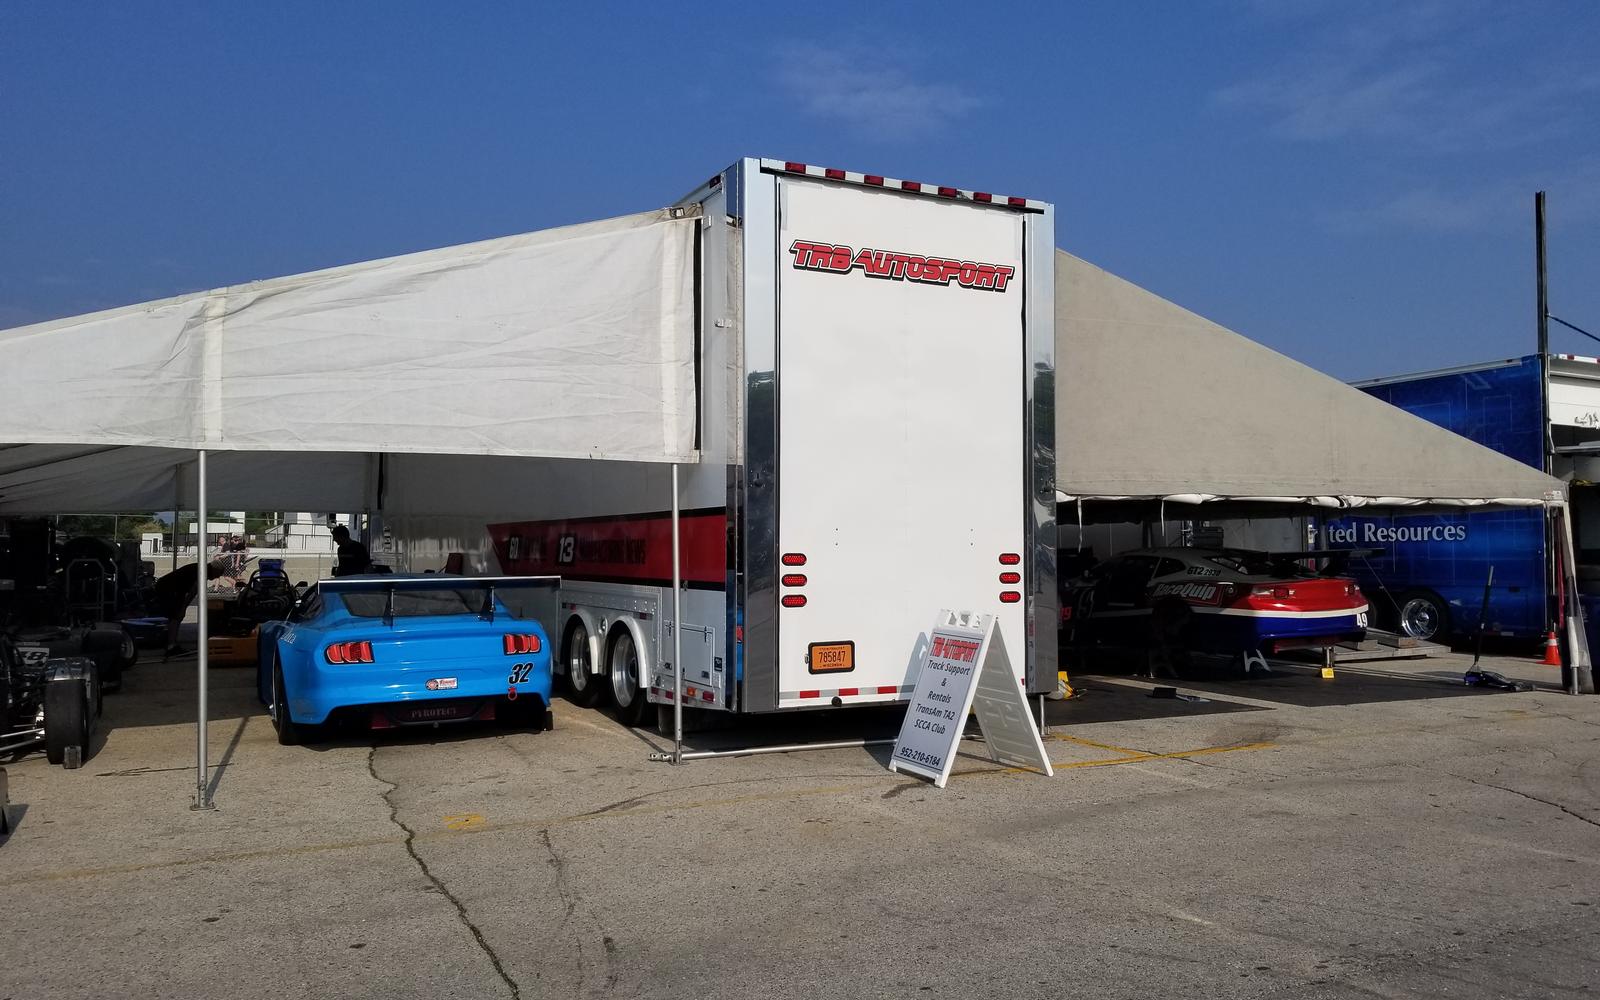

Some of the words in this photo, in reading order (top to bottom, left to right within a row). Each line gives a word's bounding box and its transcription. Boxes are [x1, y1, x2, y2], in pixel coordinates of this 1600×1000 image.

[790, 240, 855, 275] TRB
[852, 247, 1015, 293] AUTOSPORT
[1363, 522, 1466, 543] Resources
[559, 536, 575, 563] 13
[1187, 566, 1204, 575] GT2
[1153, 583, 1216, 600] RaceQuip
[1356, 613, 1368, 628] 49
[818, 650, 846, 663] 785847
[508, 662, 534, 684] 32
[928, 660, 944, 671] Track
[944, 663, 971, 676] Support
[941, 678, 947, 687] &
[927, 691, 952, 704] Rentals
[915, 703, 942, 718] TransAm
[942, 709, 956, 721] TA2
[914, 718, 931, 731] SCCA
[931, 723, 946, 735] Club
[901, 746, 941, 766] 952-210-6184
